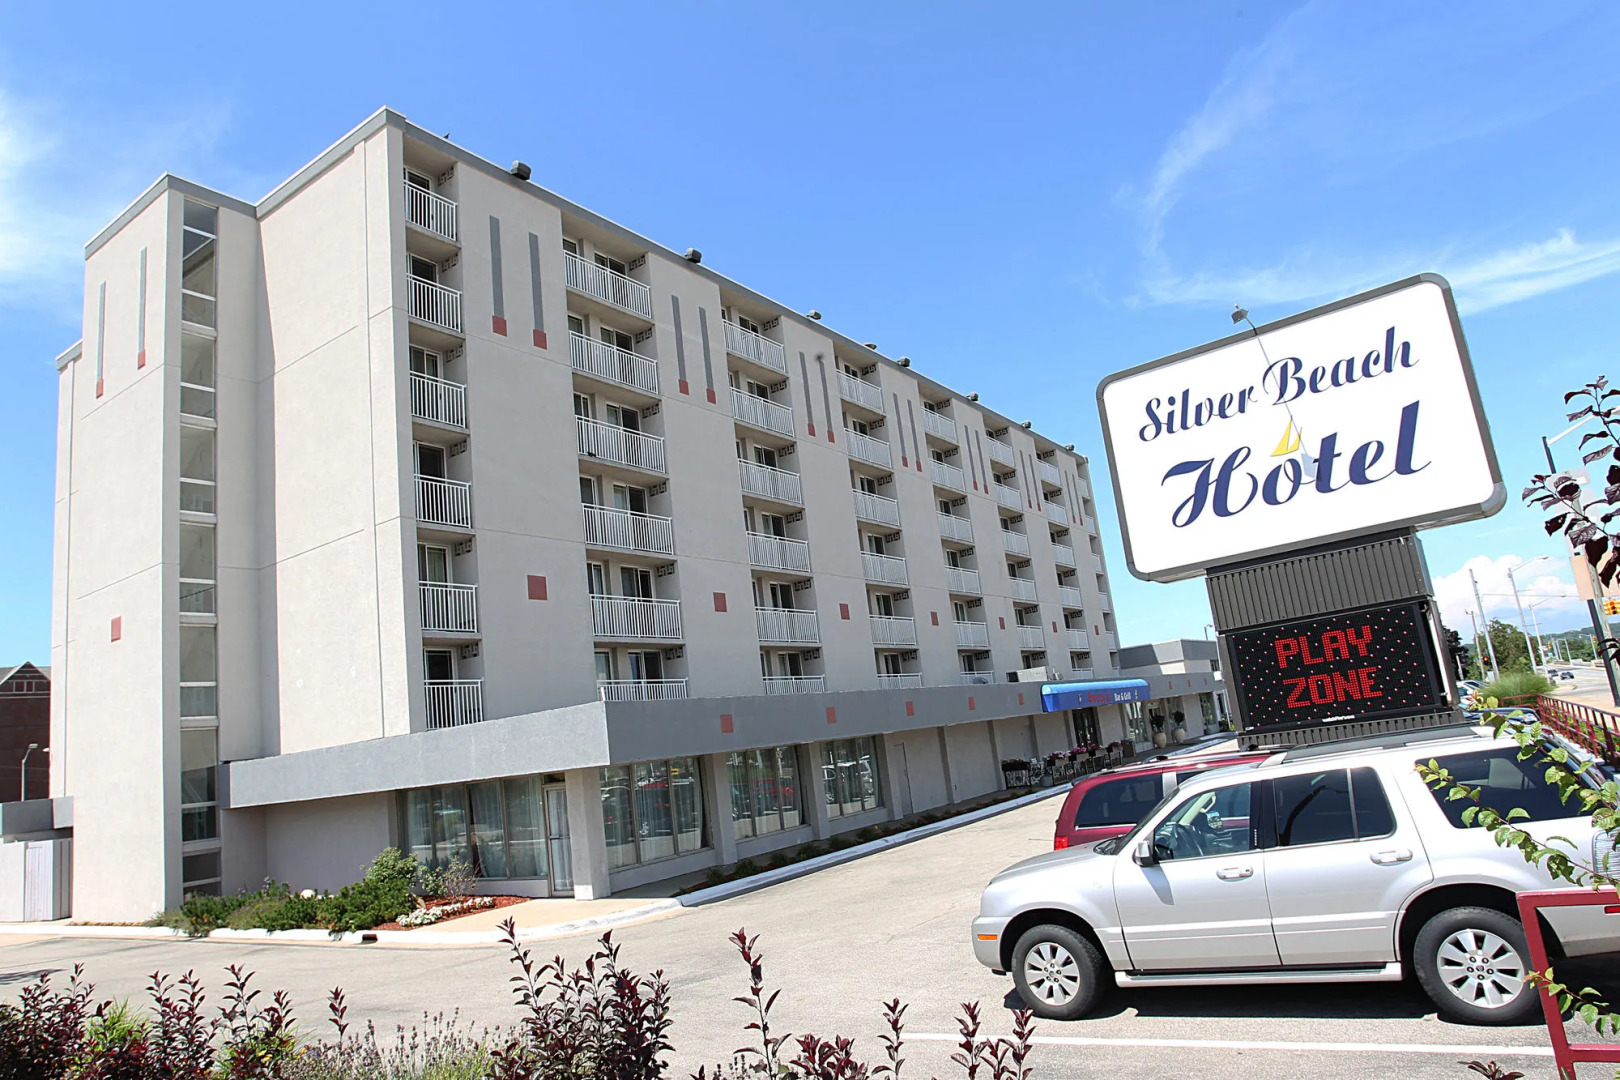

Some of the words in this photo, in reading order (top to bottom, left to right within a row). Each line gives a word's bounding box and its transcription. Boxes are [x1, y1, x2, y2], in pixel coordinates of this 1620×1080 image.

[1138, 385, 1258, 442] Silver
[1262, 325, 1420, 405] Beach
[1161, 400, 1432, 528] Hotel
[1274, 625, 1374, 669] PLAY
[1283, 666, 1383, 709] ZONE
